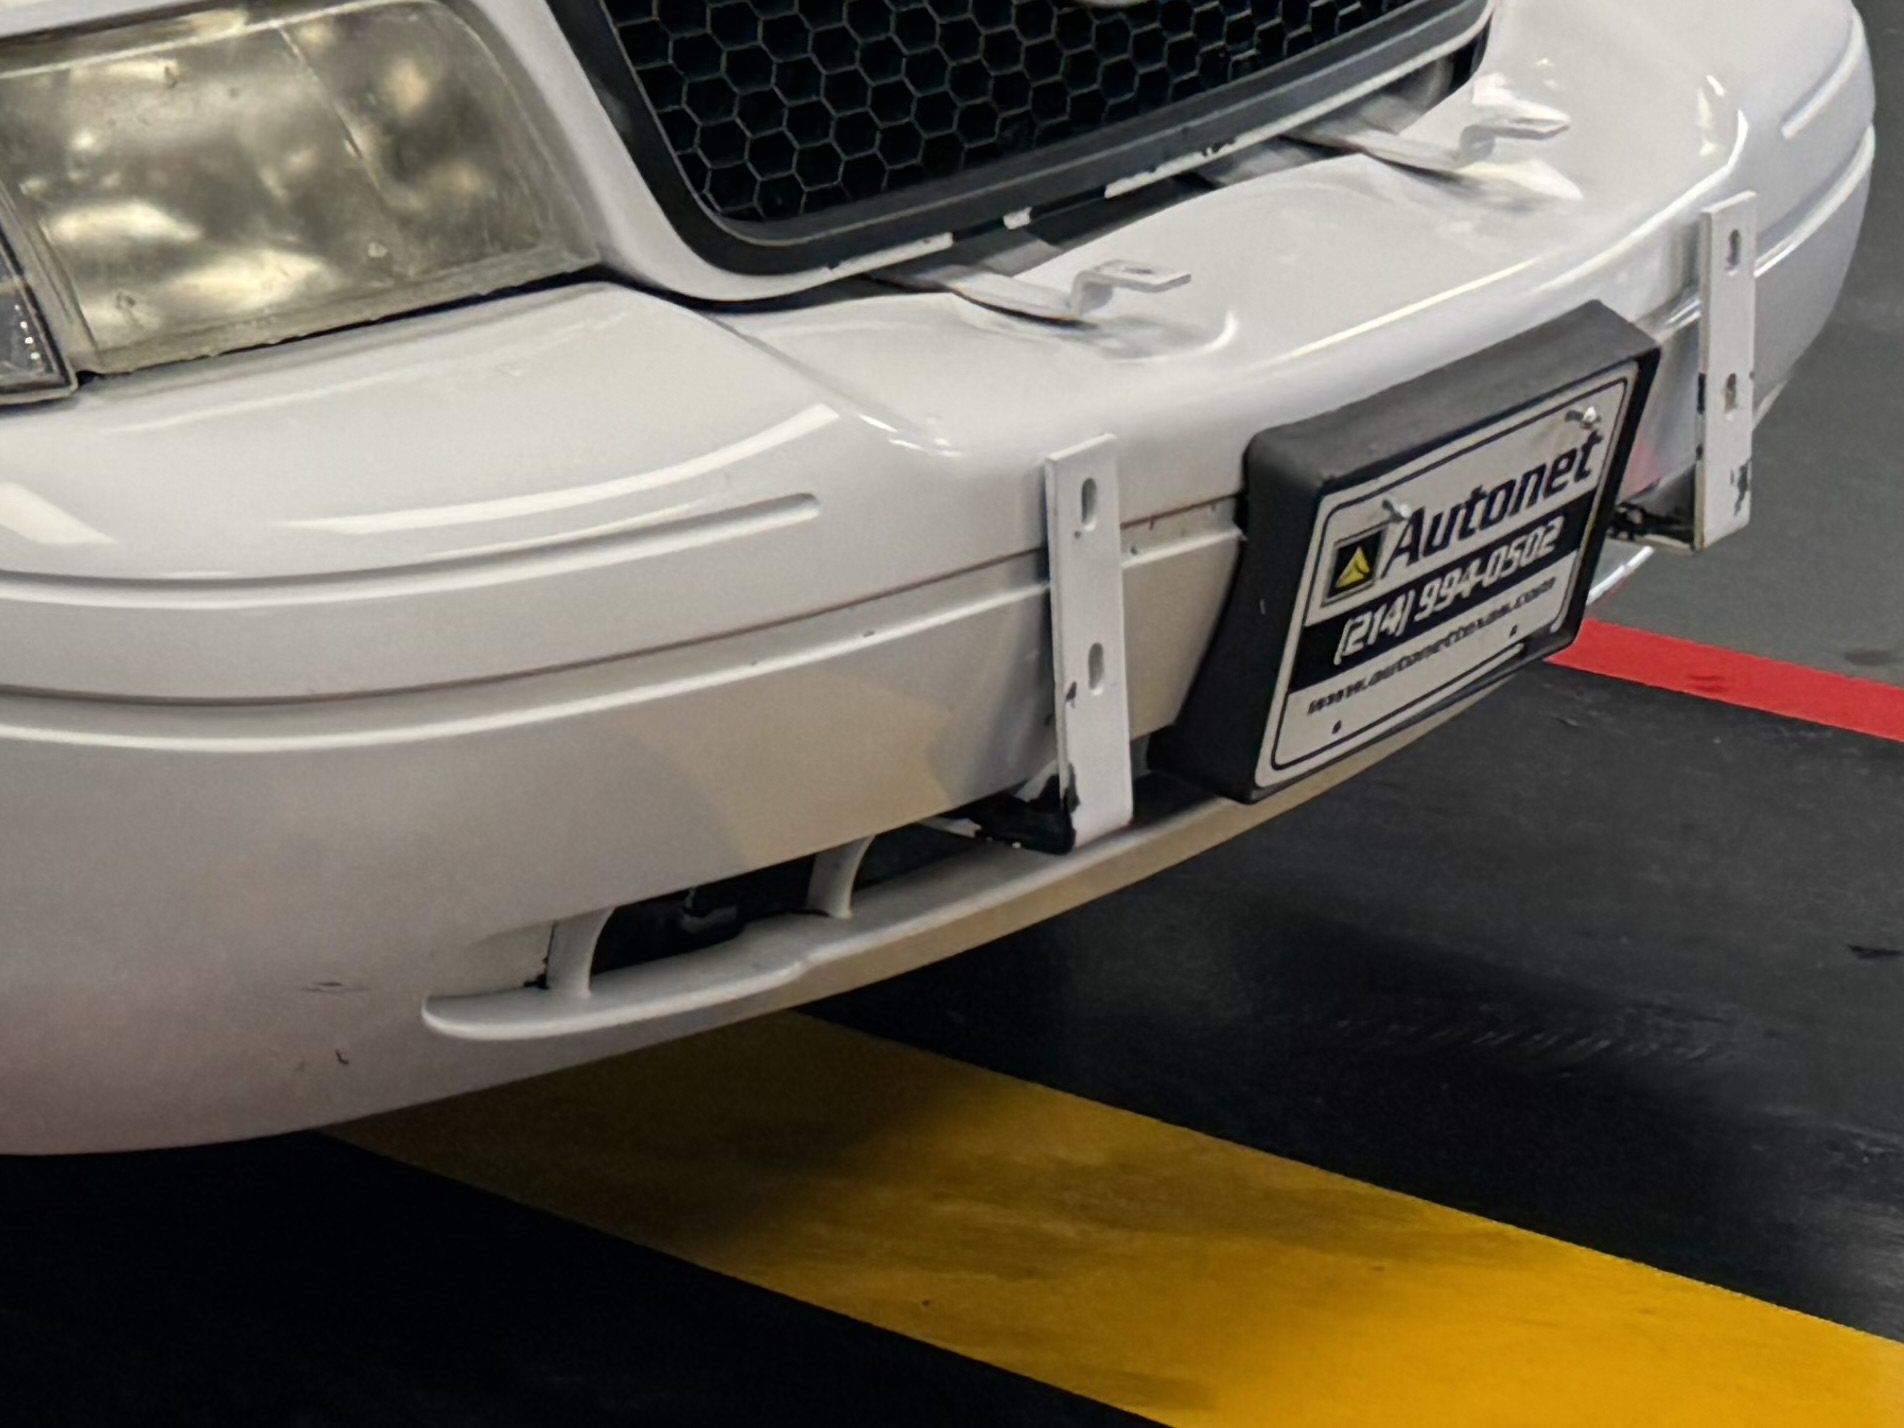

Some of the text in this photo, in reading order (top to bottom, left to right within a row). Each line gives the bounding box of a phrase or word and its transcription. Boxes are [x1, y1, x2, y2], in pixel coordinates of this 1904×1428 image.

[1381, 430, 1602, 579] Autonet
[1333, 517, 1564, 665] (214) 994-0502
